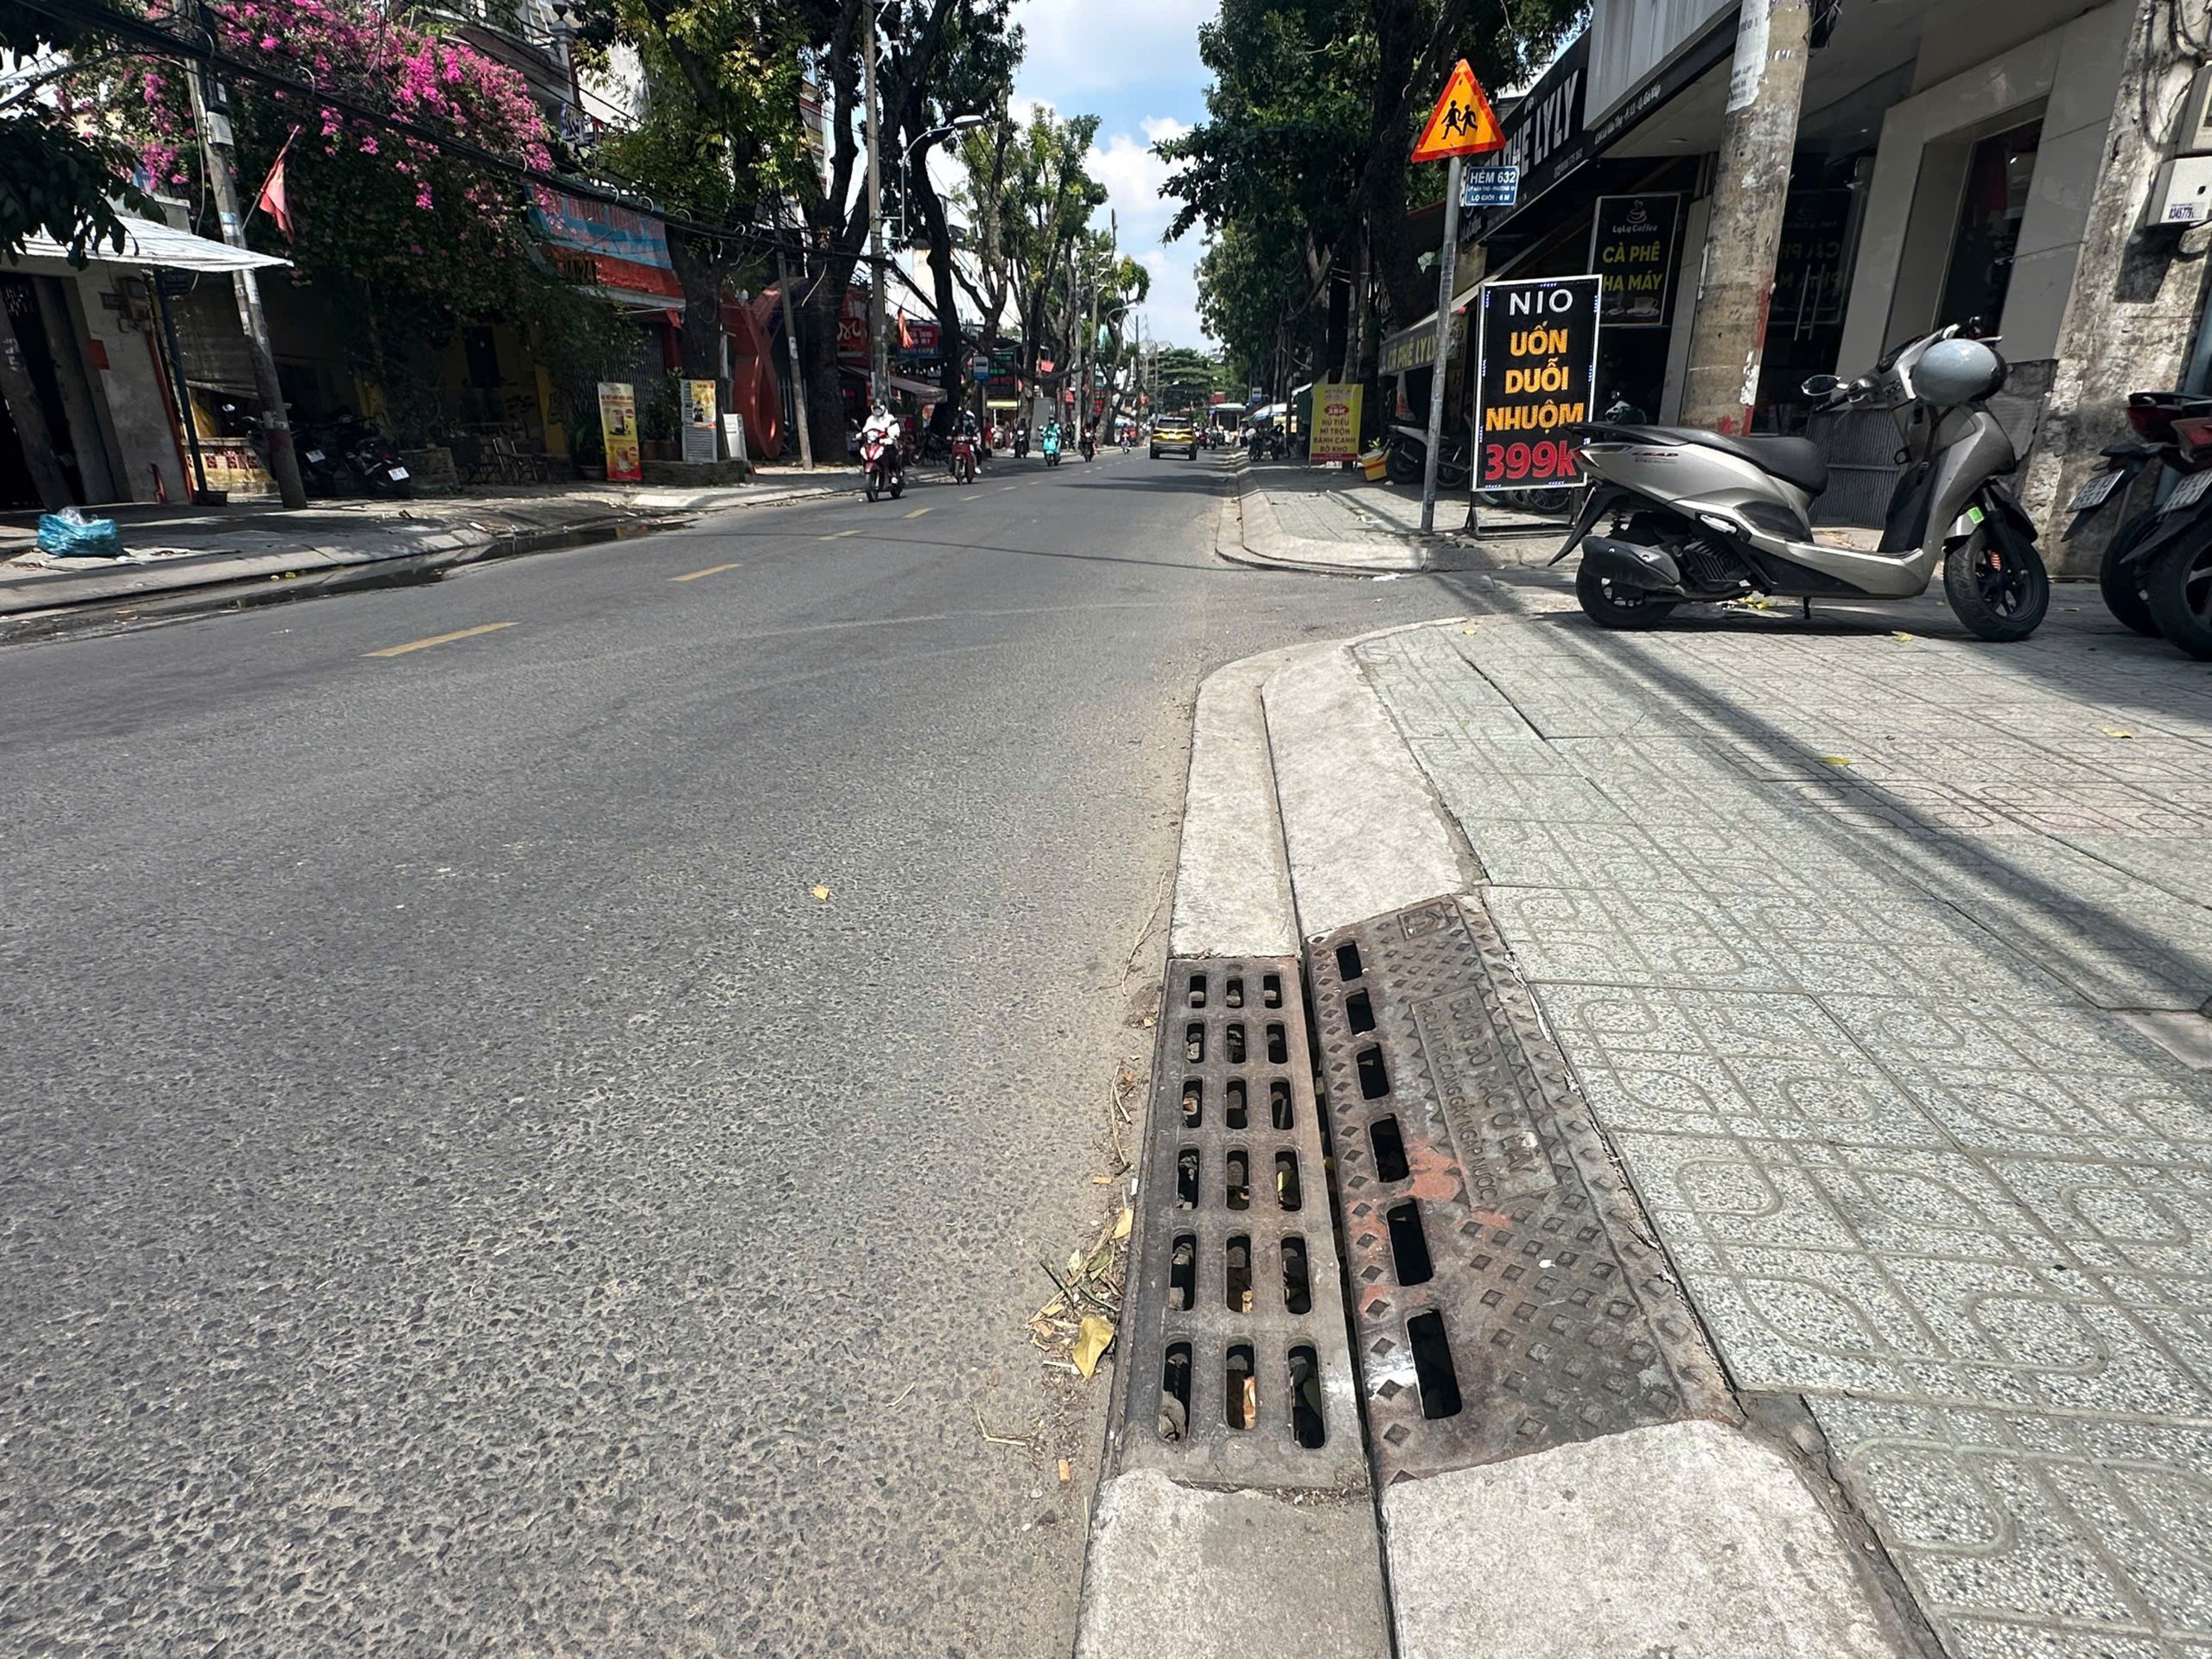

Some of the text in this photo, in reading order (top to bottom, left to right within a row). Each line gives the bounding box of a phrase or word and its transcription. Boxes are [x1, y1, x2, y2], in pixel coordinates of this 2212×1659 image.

[1535, 69, 1579, 166] LYLY
[1470, 169, 1516, 183] HẺM 632
[1602, 240, 1660, 263] CÀ PHÊ
[1601, 270, 1663, 291] HA MÁY
[1509, 289, 1573, 315] NIO
[1510, 321, 1568, 357] UỐN
[1505, 357, 1569, 394] DUỖI
[1331, 427, 1350, 435] TRỘN
[1334, 416, 1350, 426] TIẾU
[1485, 399, 1585, 434] NHUỘM
[1484, 440, 1577, 480] 399k
[1439, 1062, 1471, 1096] CỐNG
[1477, 1068, 1514, 1109] RÁC
[1448, 1096, 1476, 1120] GÂY
[1469, 1156, 1504, 1201] NƯỚC
